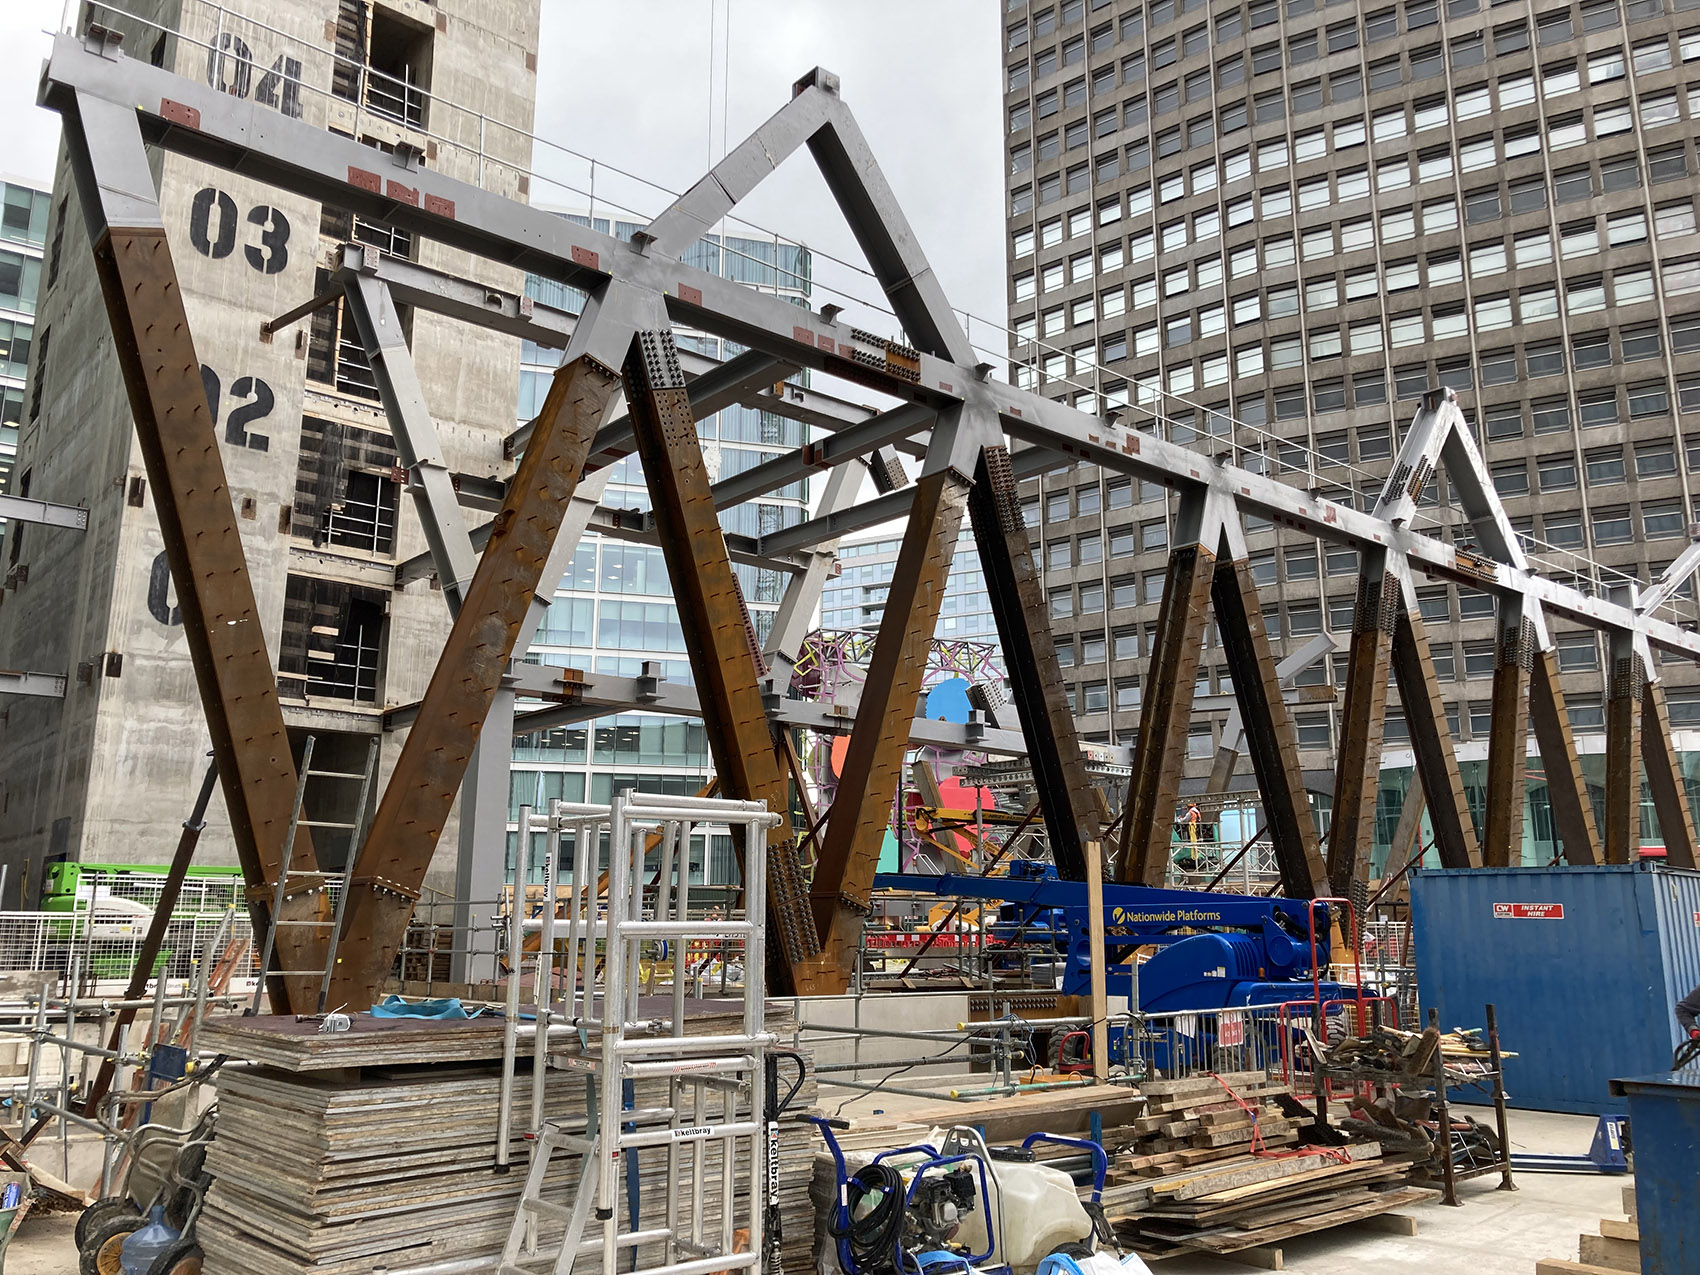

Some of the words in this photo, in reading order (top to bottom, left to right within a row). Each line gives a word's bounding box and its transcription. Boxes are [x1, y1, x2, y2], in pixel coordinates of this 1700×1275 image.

[206, 32, 304, 119] 04
[189, 187, 291, 275] 03
[1126, 910, 1176, 922] Nationwide
[1177, 909, 1221, 921] Platforms
[680, 1127, 711, 1137] keltbray
[770, 1139, 779, 1198] keltbray
